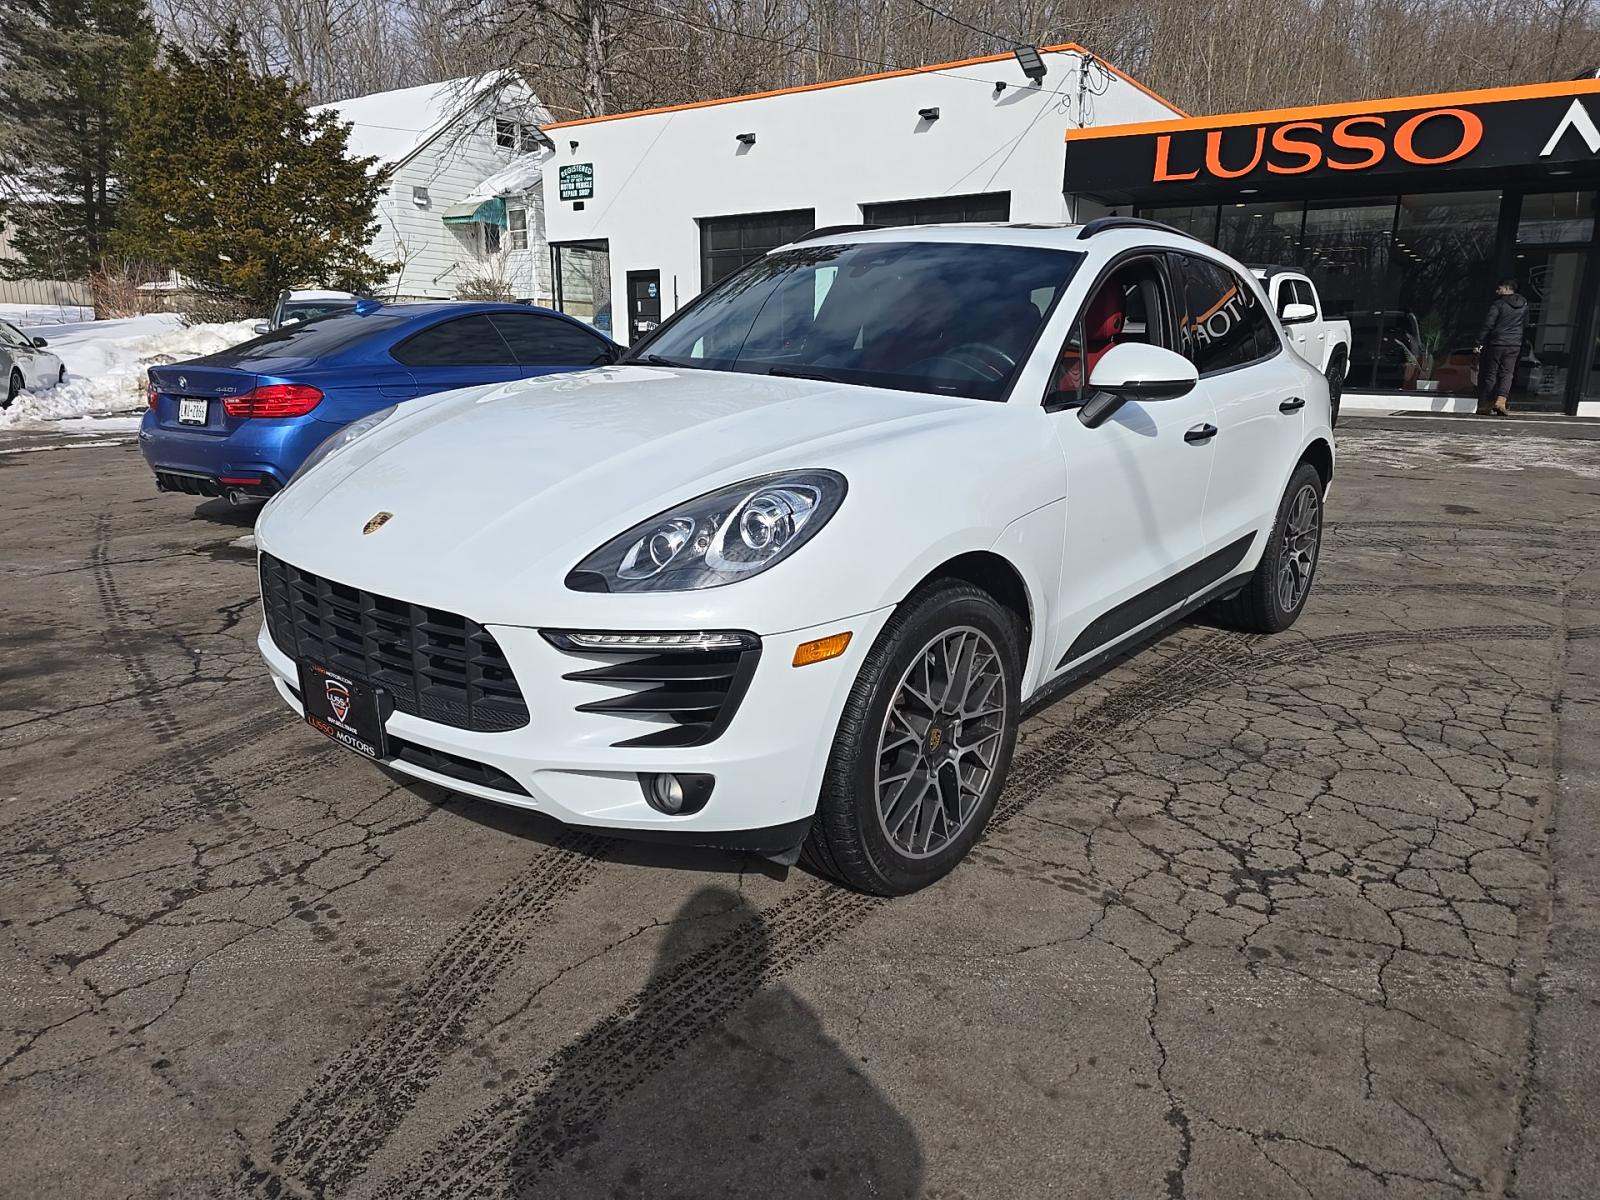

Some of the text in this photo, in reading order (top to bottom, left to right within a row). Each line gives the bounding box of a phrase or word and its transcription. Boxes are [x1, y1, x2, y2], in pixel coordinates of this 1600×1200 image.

[1153, 109, 1484, 183] LUSSO
[561, 164, 592, 178] REGISTERED
[561, 180, 592, 190] MOTOR VEHICLE
[563, 188, 590, 198] REPAIR SHOP
[308, 715, 376, 757] LUSSO MOTORS
